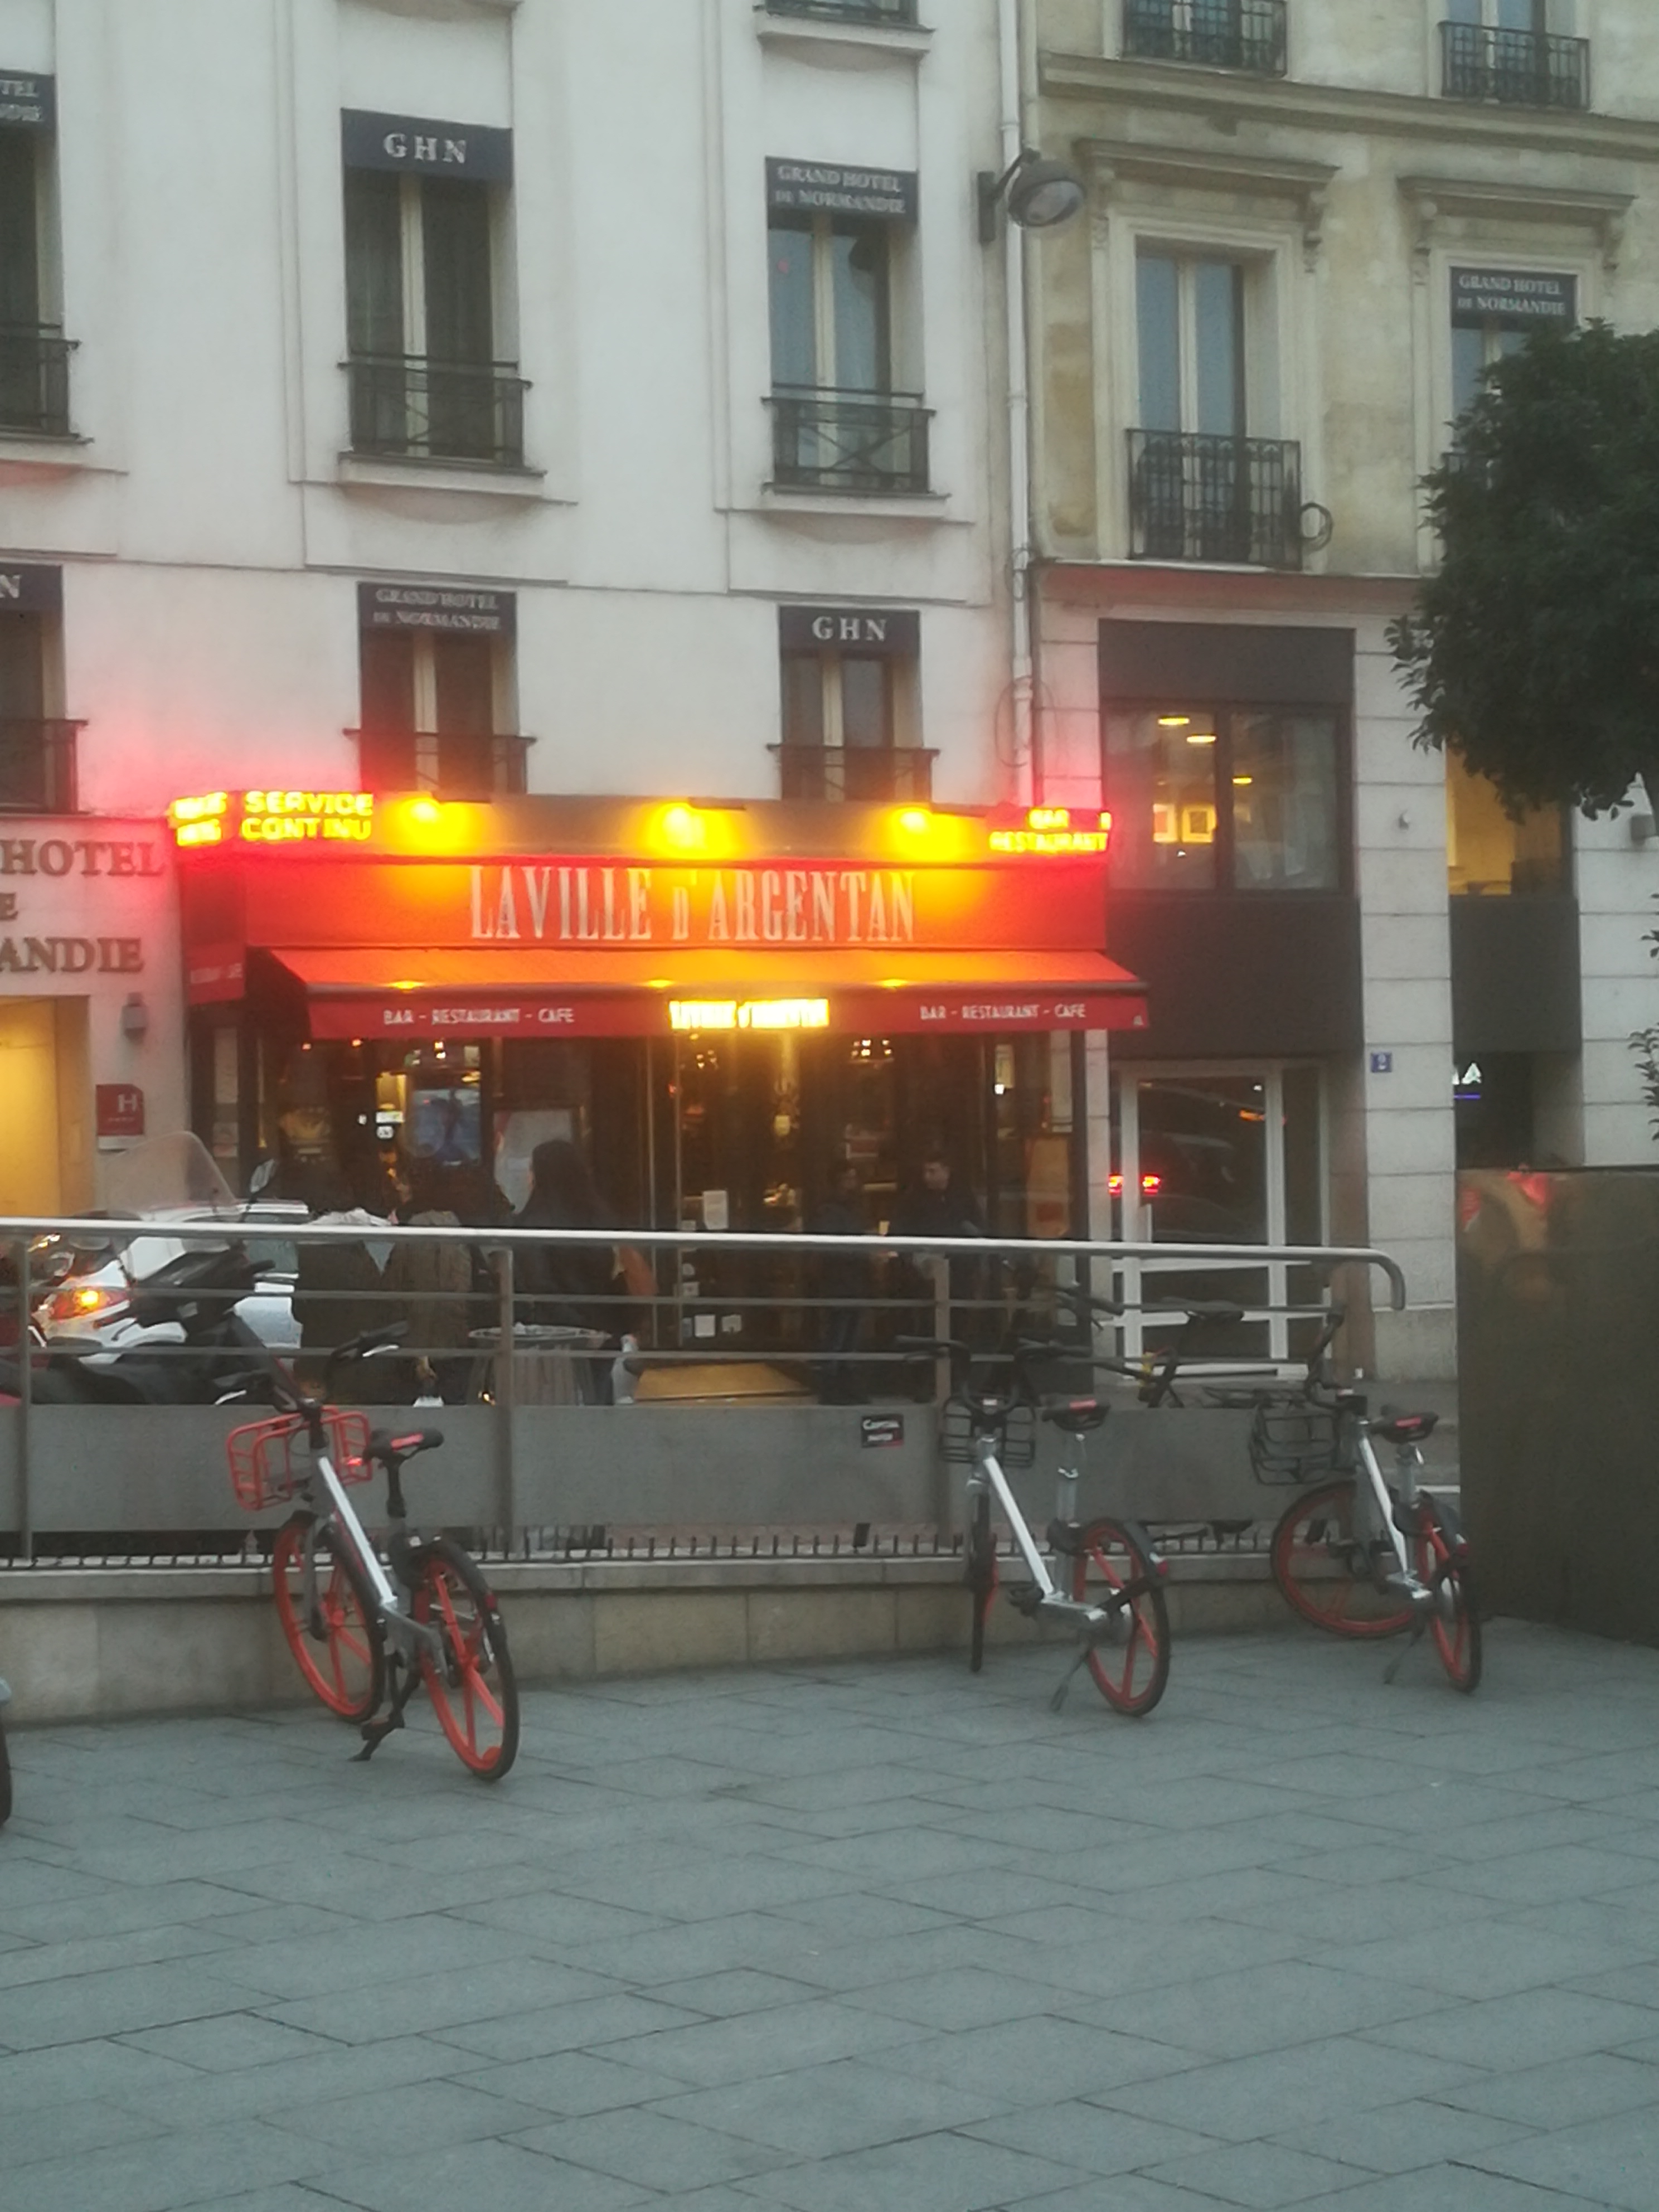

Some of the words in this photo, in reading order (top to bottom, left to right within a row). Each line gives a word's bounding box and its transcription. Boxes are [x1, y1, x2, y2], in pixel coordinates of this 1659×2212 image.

[384, 133, 467, 164] GHN
[1458, 274, 1511, 291] GRAND
[1514, 279, 1561, 294] HOTEL
[812, 615, 887, 642] GHN
[244, 790, 373, 816] SERVICE
[241, 817, 372, 841] CONTINU
[0, 839, 164, 877] HOTEL
[0, 937, 145, 972] ANDIE
[383, 1009, 414, 1025] BAR
[431, 1008, 521, 1025] RESTAURANT
[537, 1007, 575, 1023] CAFE
[920, 1005, 946, 1020] BAR
[961, 1005, 1040, 1020] RESTAURANT
[1054, 1004, 1087, 1018] CAFE
[118, 1093, 137, 1113] H
